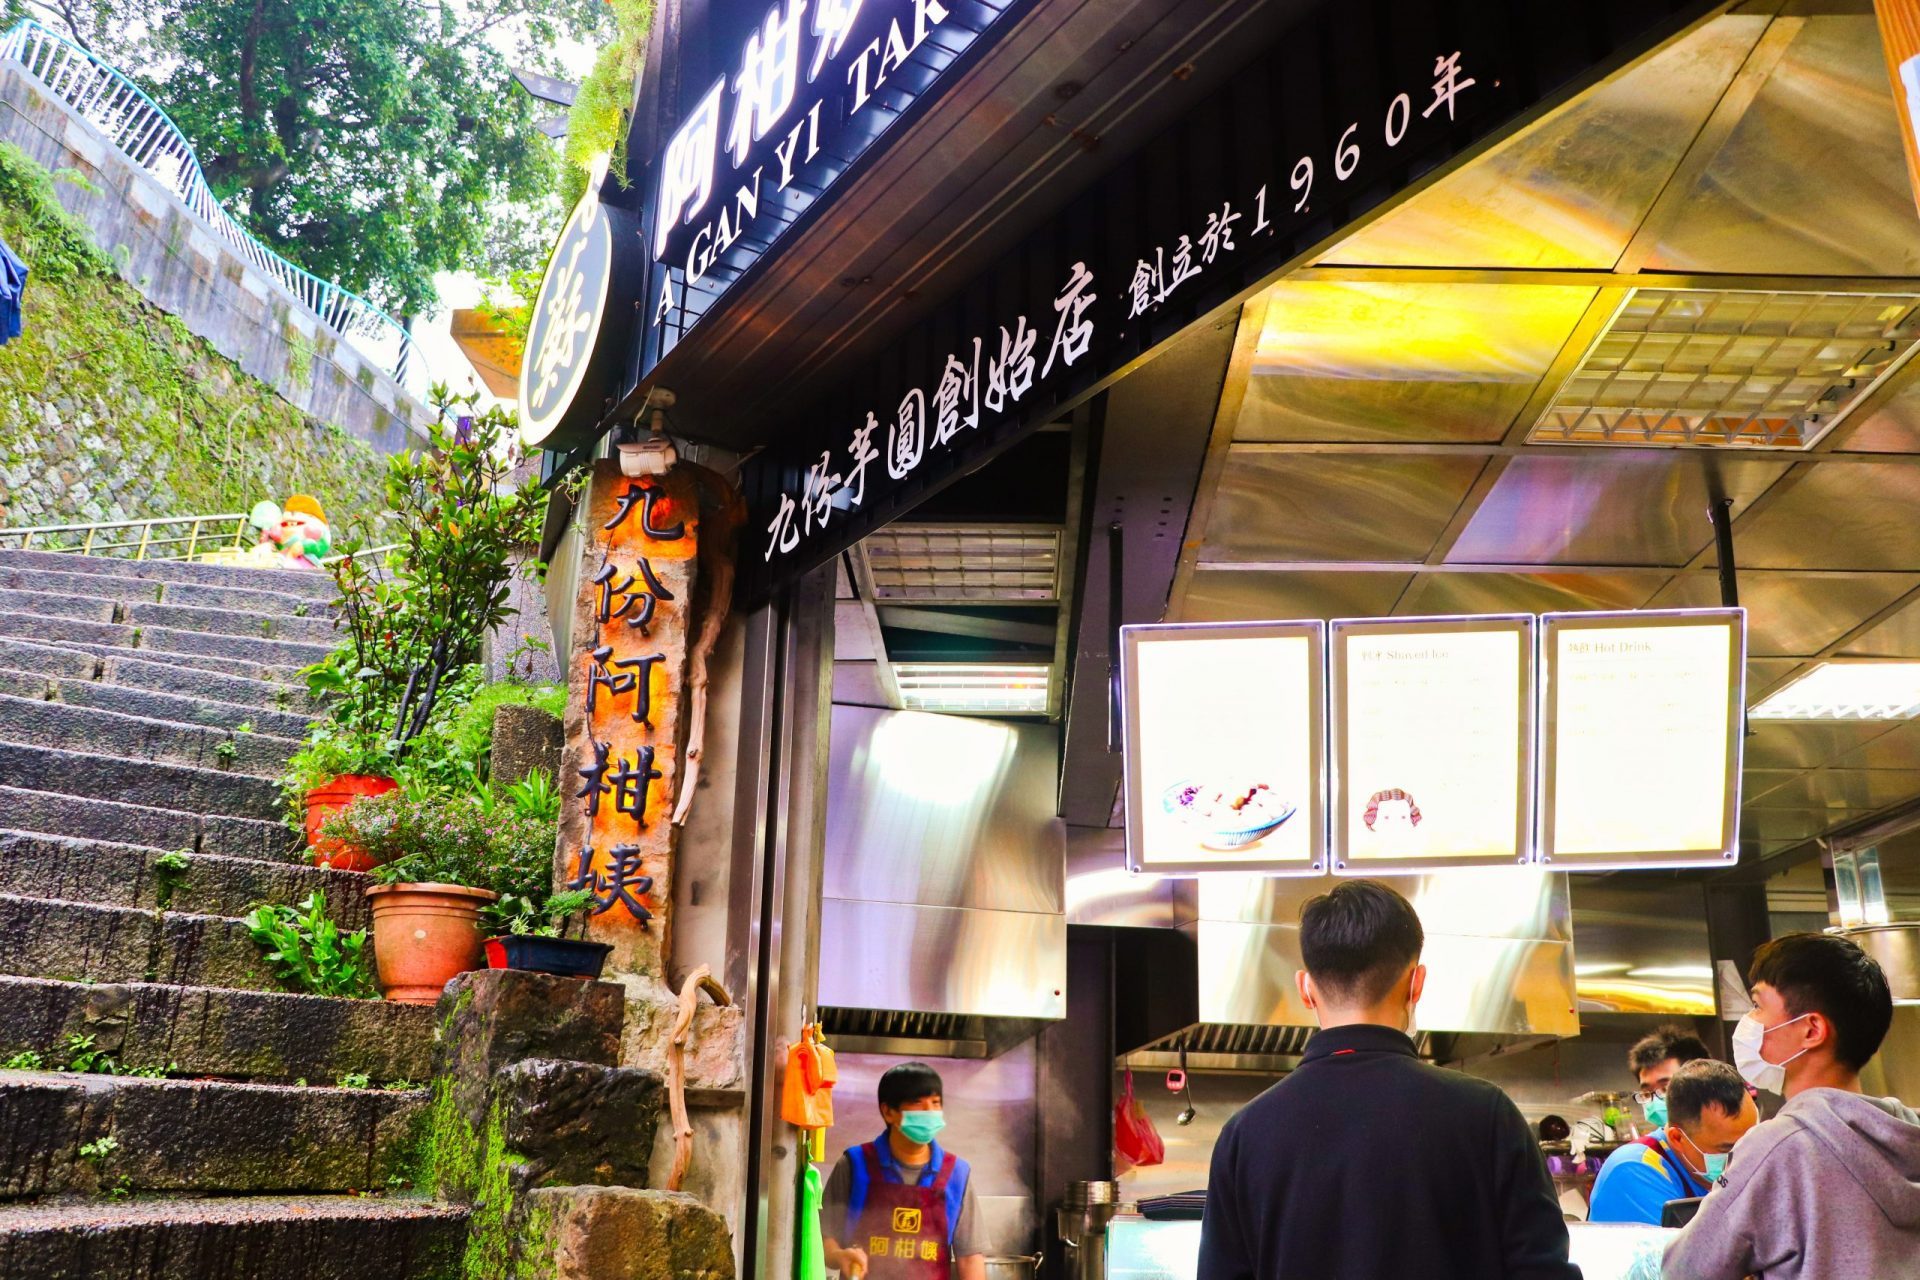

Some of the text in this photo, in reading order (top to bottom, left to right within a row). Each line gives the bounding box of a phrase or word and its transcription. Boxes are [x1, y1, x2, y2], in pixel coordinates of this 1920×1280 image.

[653, 270, 675, 327] A
[686, 166, 763, 285] GAN
[775, 99, 823, 192] YI
[765, 262, 1097, 562] 九份芋圓創始店
[568, 484, 685, 925] 九份阿柑姨
[1595, 641, 1615, 653] Hot
[1619, 640, 1653, 653] Drink
